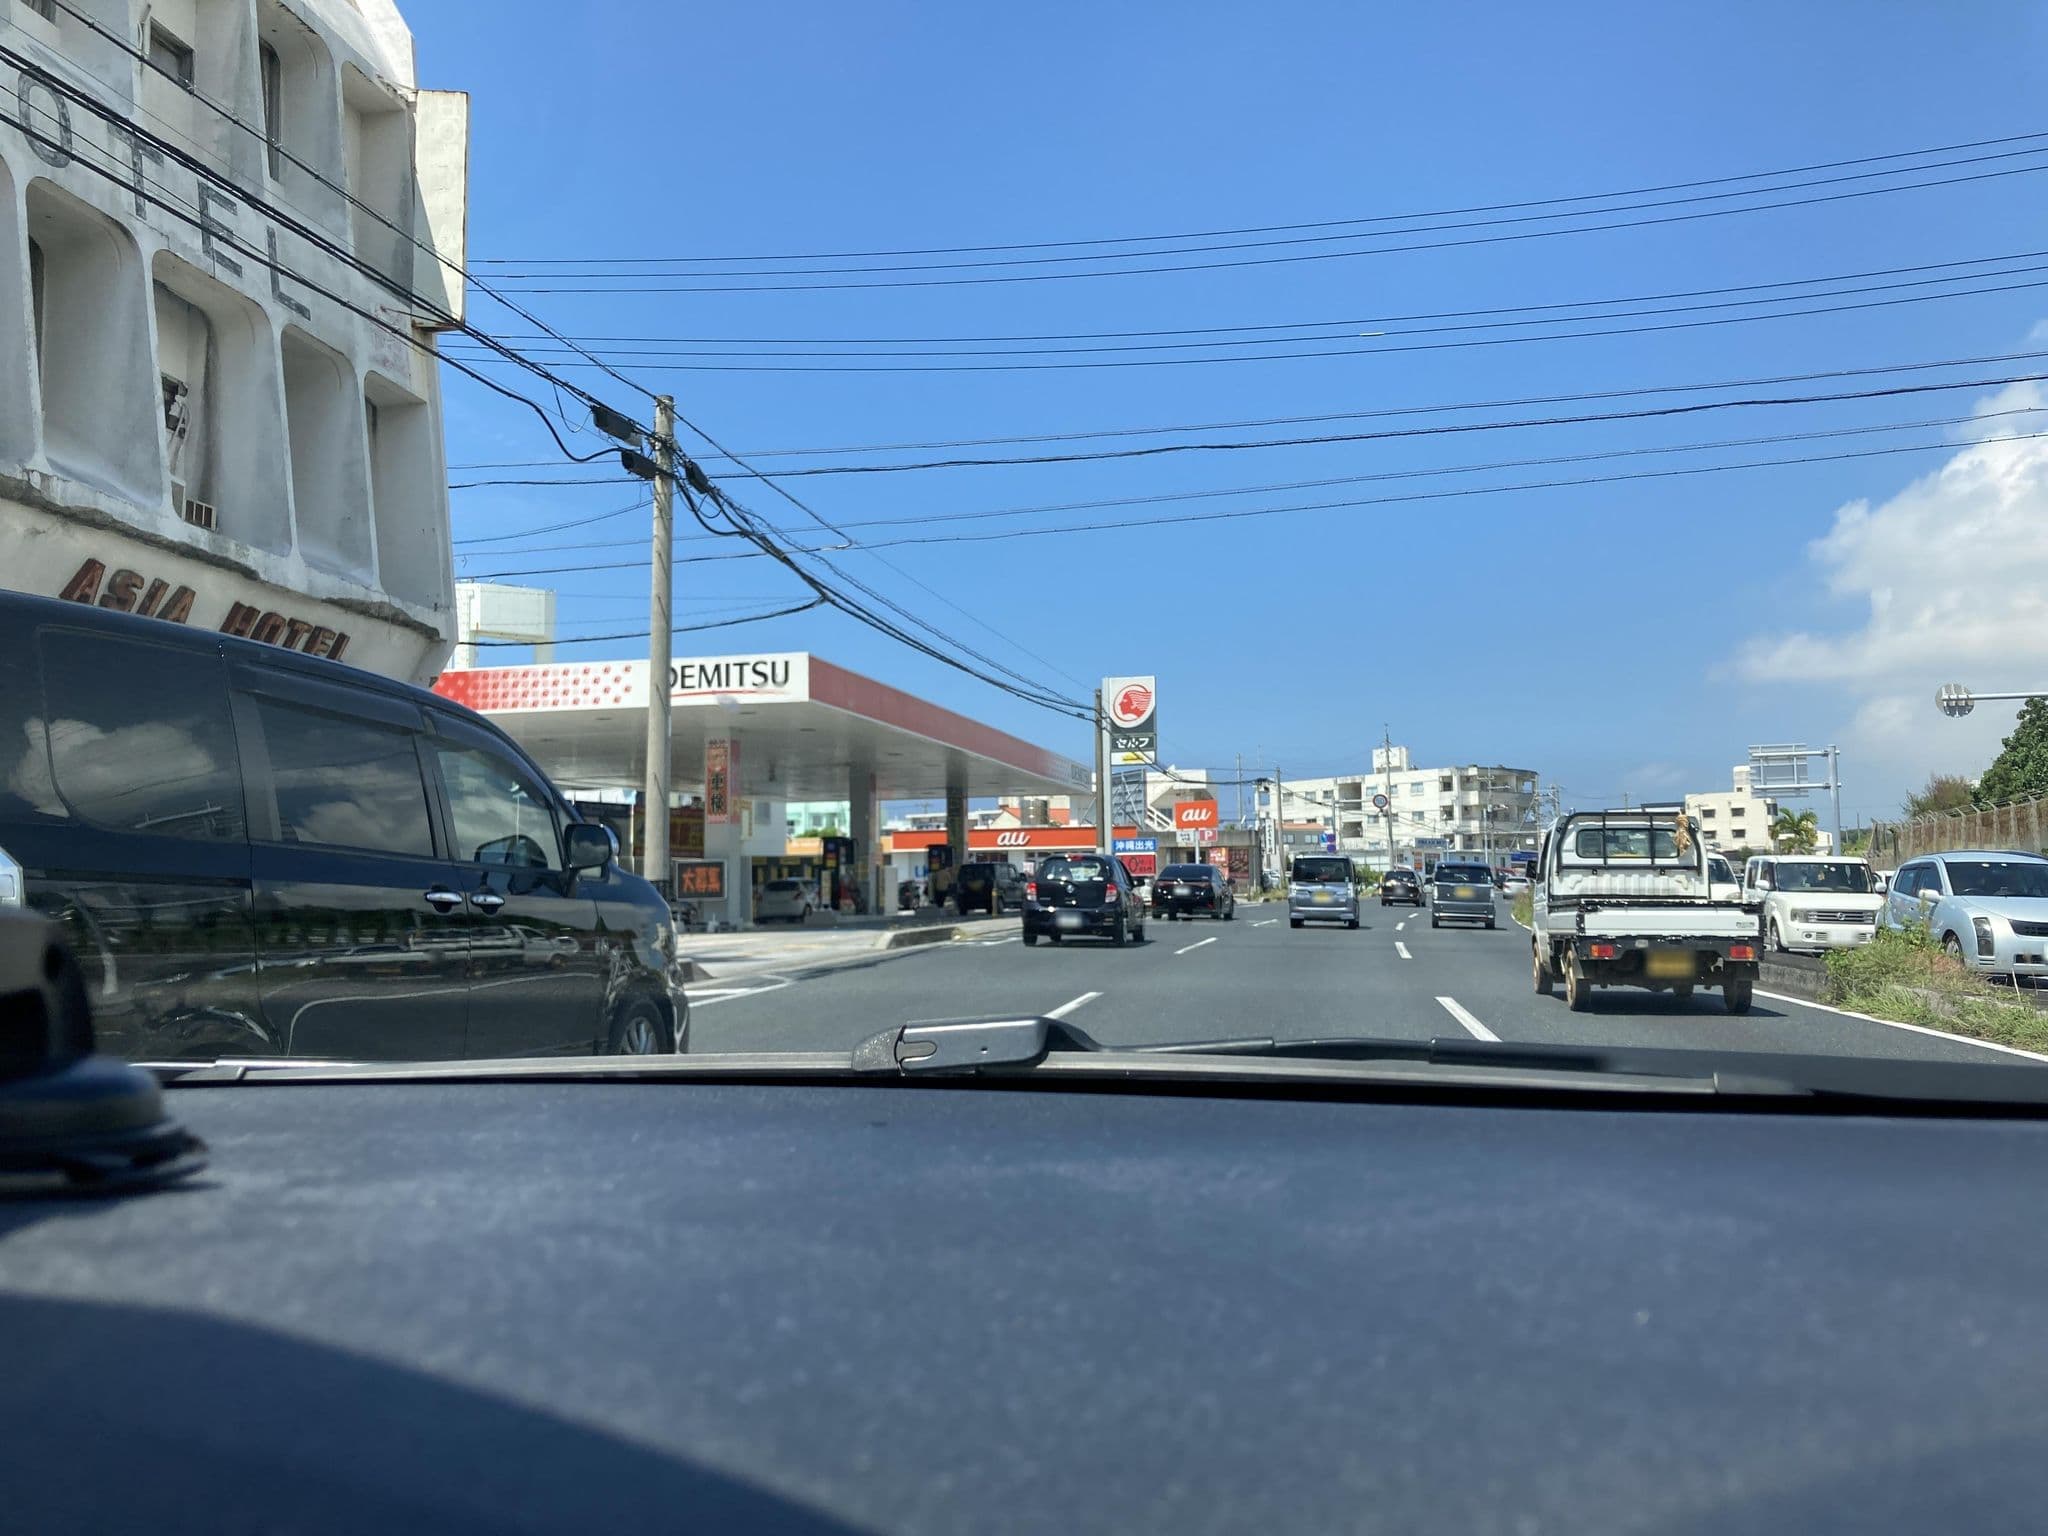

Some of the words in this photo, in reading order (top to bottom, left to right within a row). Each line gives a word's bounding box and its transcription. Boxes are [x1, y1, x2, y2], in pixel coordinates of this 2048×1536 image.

[59, 558, 196, 625] ASIA
[670, 661, 789, 689] EMITSU
[1116, 737, 1149, 749] セルフ
[1182, 807, 1211, 822] au
[997, 831, 1031, 847] au
[1204, 830, 1213, 841] P
